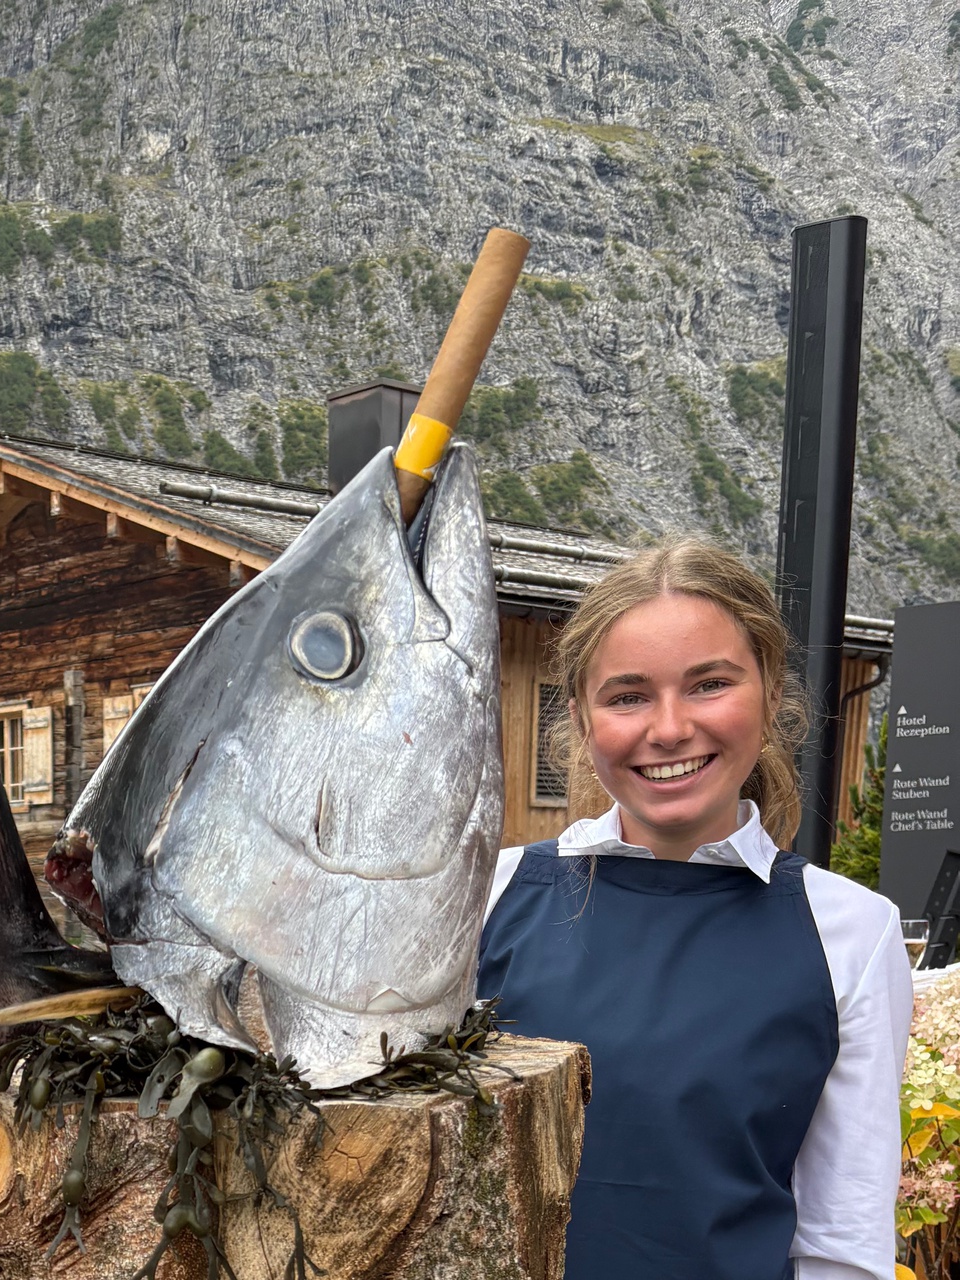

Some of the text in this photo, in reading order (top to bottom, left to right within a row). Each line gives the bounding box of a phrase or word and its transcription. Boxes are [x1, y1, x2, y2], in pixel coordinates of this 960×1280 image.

[897, 714, 926, 726] Hotel
[896, 725, 950, 738] Rezeption
[892, 775, 950, 789] Rote Wand
[891, 788, 930, 800] Stuben
[890, 807, 948, 821] Rote Wand
[890, 819, 954, 832] Chef's Table
